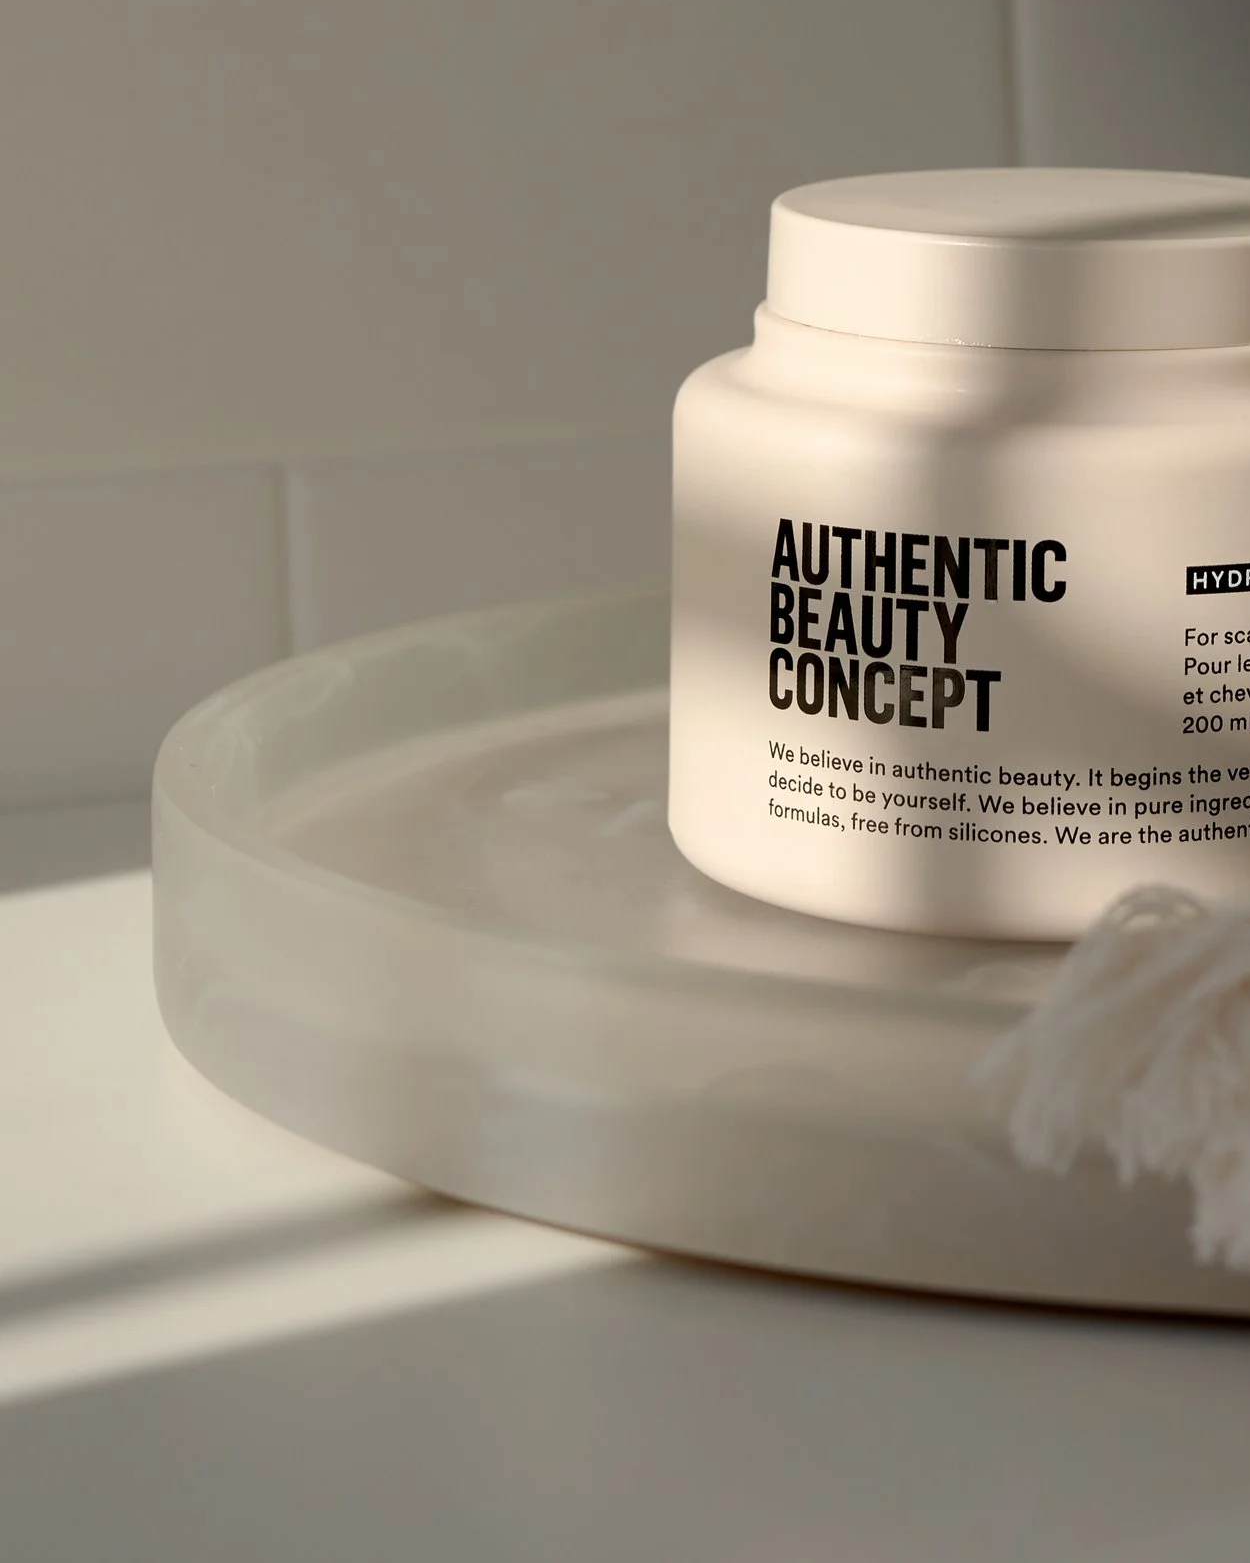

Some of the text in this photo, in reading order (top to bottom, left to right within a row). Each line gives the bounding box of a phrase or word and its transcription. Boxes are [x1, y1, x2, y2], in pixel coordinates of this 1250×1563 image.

[771, 518, 1067, 603] AUTHENTIC
[770, 582, 969, 664] BEAUTY
[1185, 628, 1218, 646] For
[769, 647, 1001, 731] CONCEPT
[1185, 657, 1231, 675] Pour
[1183, 688, 1203, 705] et
[1183, 715, 1223, 733] 200
[769, 741, 794, 762] We
[800, 746, 863, 773] believe
[870, 757, 885, 775] in
[892, 762, 991, 784] authentic
[999, 766, 1080, 791] beauty.
[1089, 769, 1103, 786] It
[1111, 767, 1181, 790] begins
[1188, 765, 1221, 784] the
[769, 770, 823, 796] decide
[829, 782, 846, 799] to
[853, 783, 875, 803] be
[882, 793, 970, 812] yourself.
[978, 795, 1014, 814] We
[1023, 796, 1101, 815] believe
[1109, 797, 1126, 815] in
[1135, 801, 1183, 819] pure
[769, 798, 845, 832] formulas,
[851, 813, 889, 834] free
[895, 818, 941, 839] from
[949, 822, 1047, 844] silicones.
[1055, 826, 1091, 844] We
[1099, 832, 1132, 844] are
[1138, 825, 1172, 843] the
